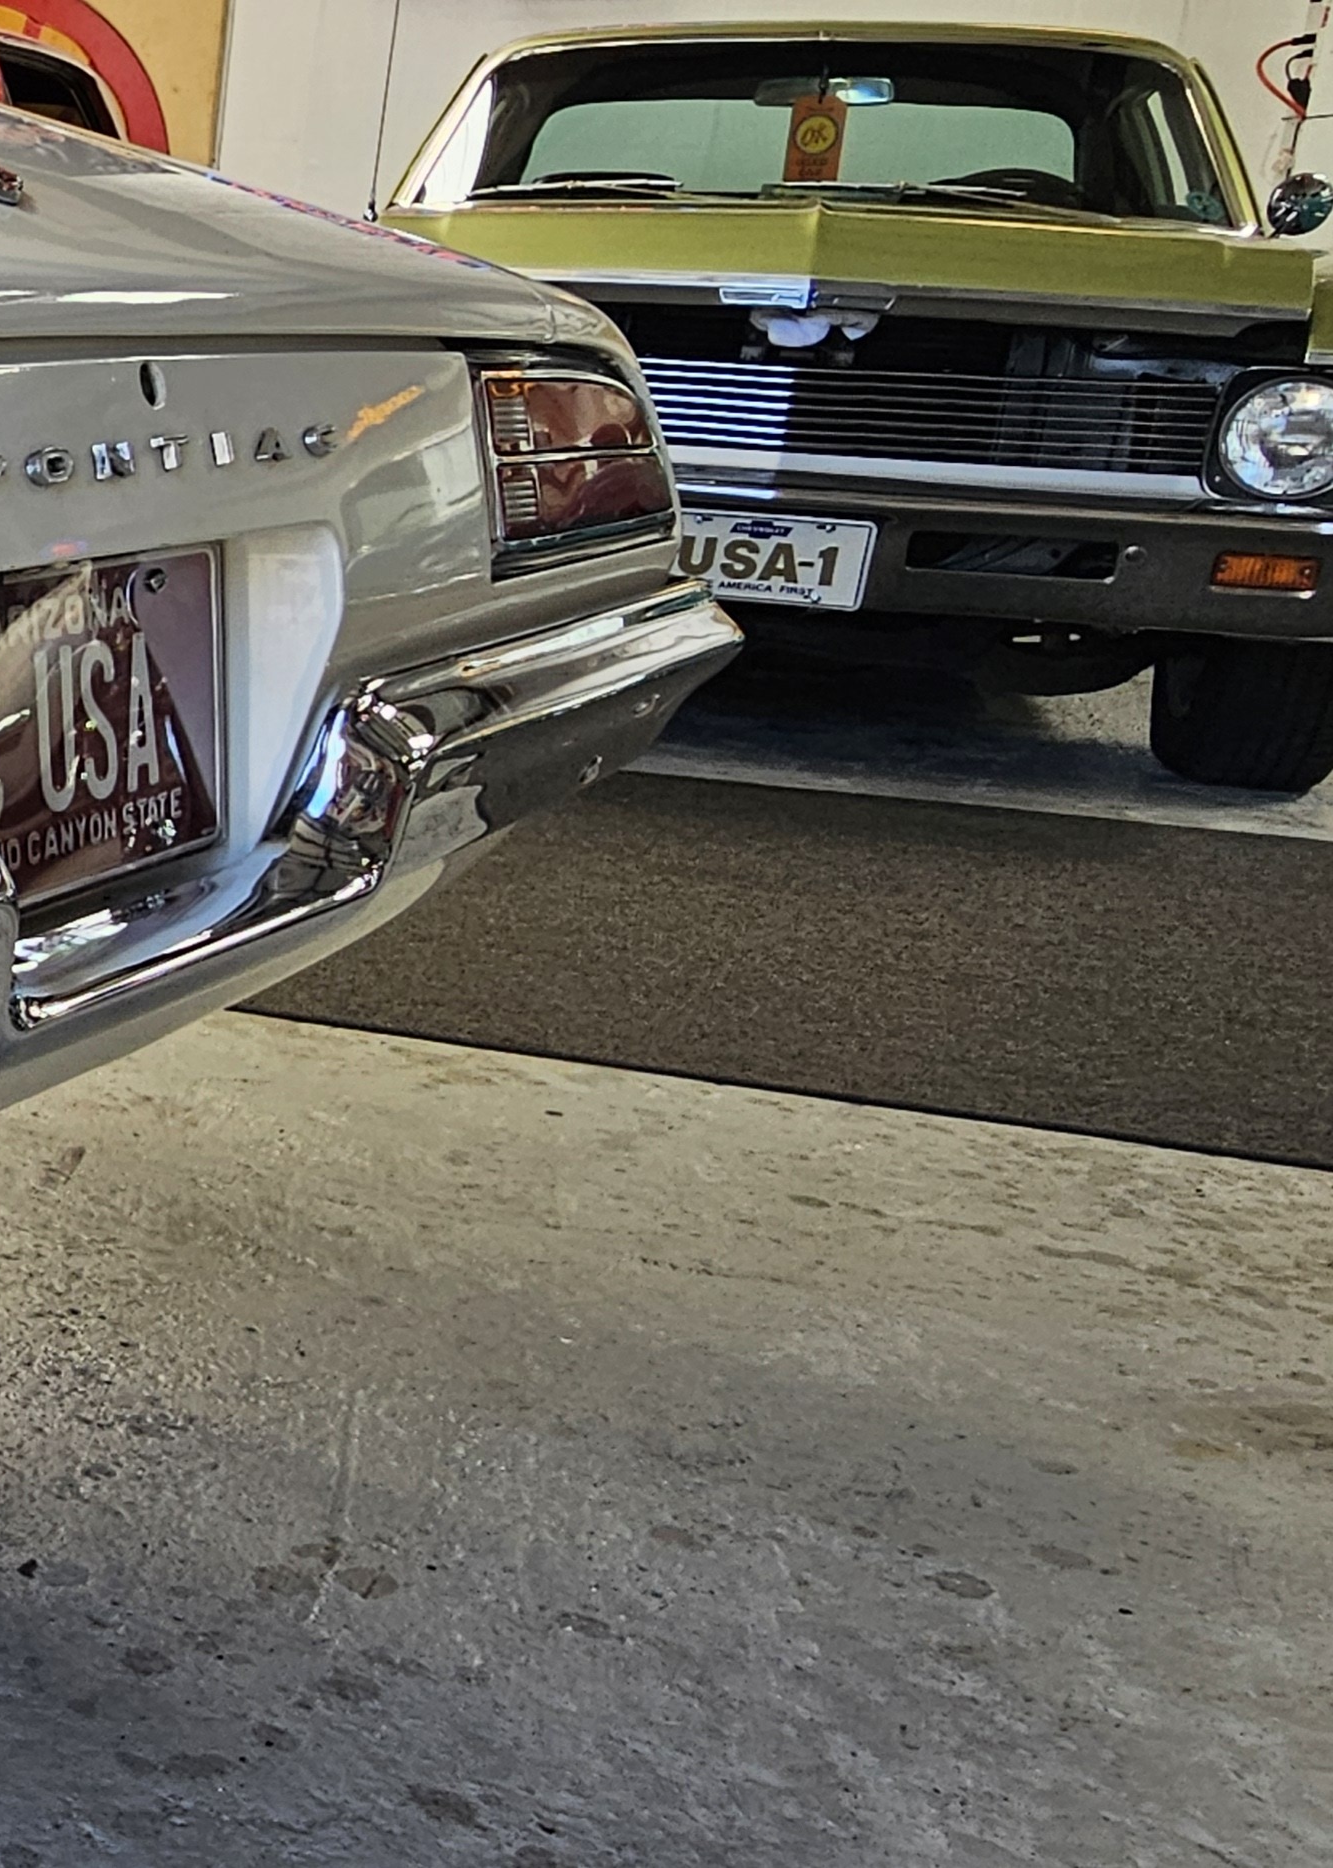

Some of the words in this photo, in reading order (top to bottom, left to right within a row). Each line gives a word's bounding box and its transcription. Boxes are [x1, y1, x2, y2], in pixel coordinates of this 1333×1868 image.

[800, 121, 828, 147] OK
[678, 535, 840, 587] USA-1
[718, 580, 773, 593] AMERICA
[779, 584, 815, 599] FIRST
[33, 630, 161, 813] USA
[27, 807, 118, 865] CANYON
[122, 786, 183, 836] STATE
